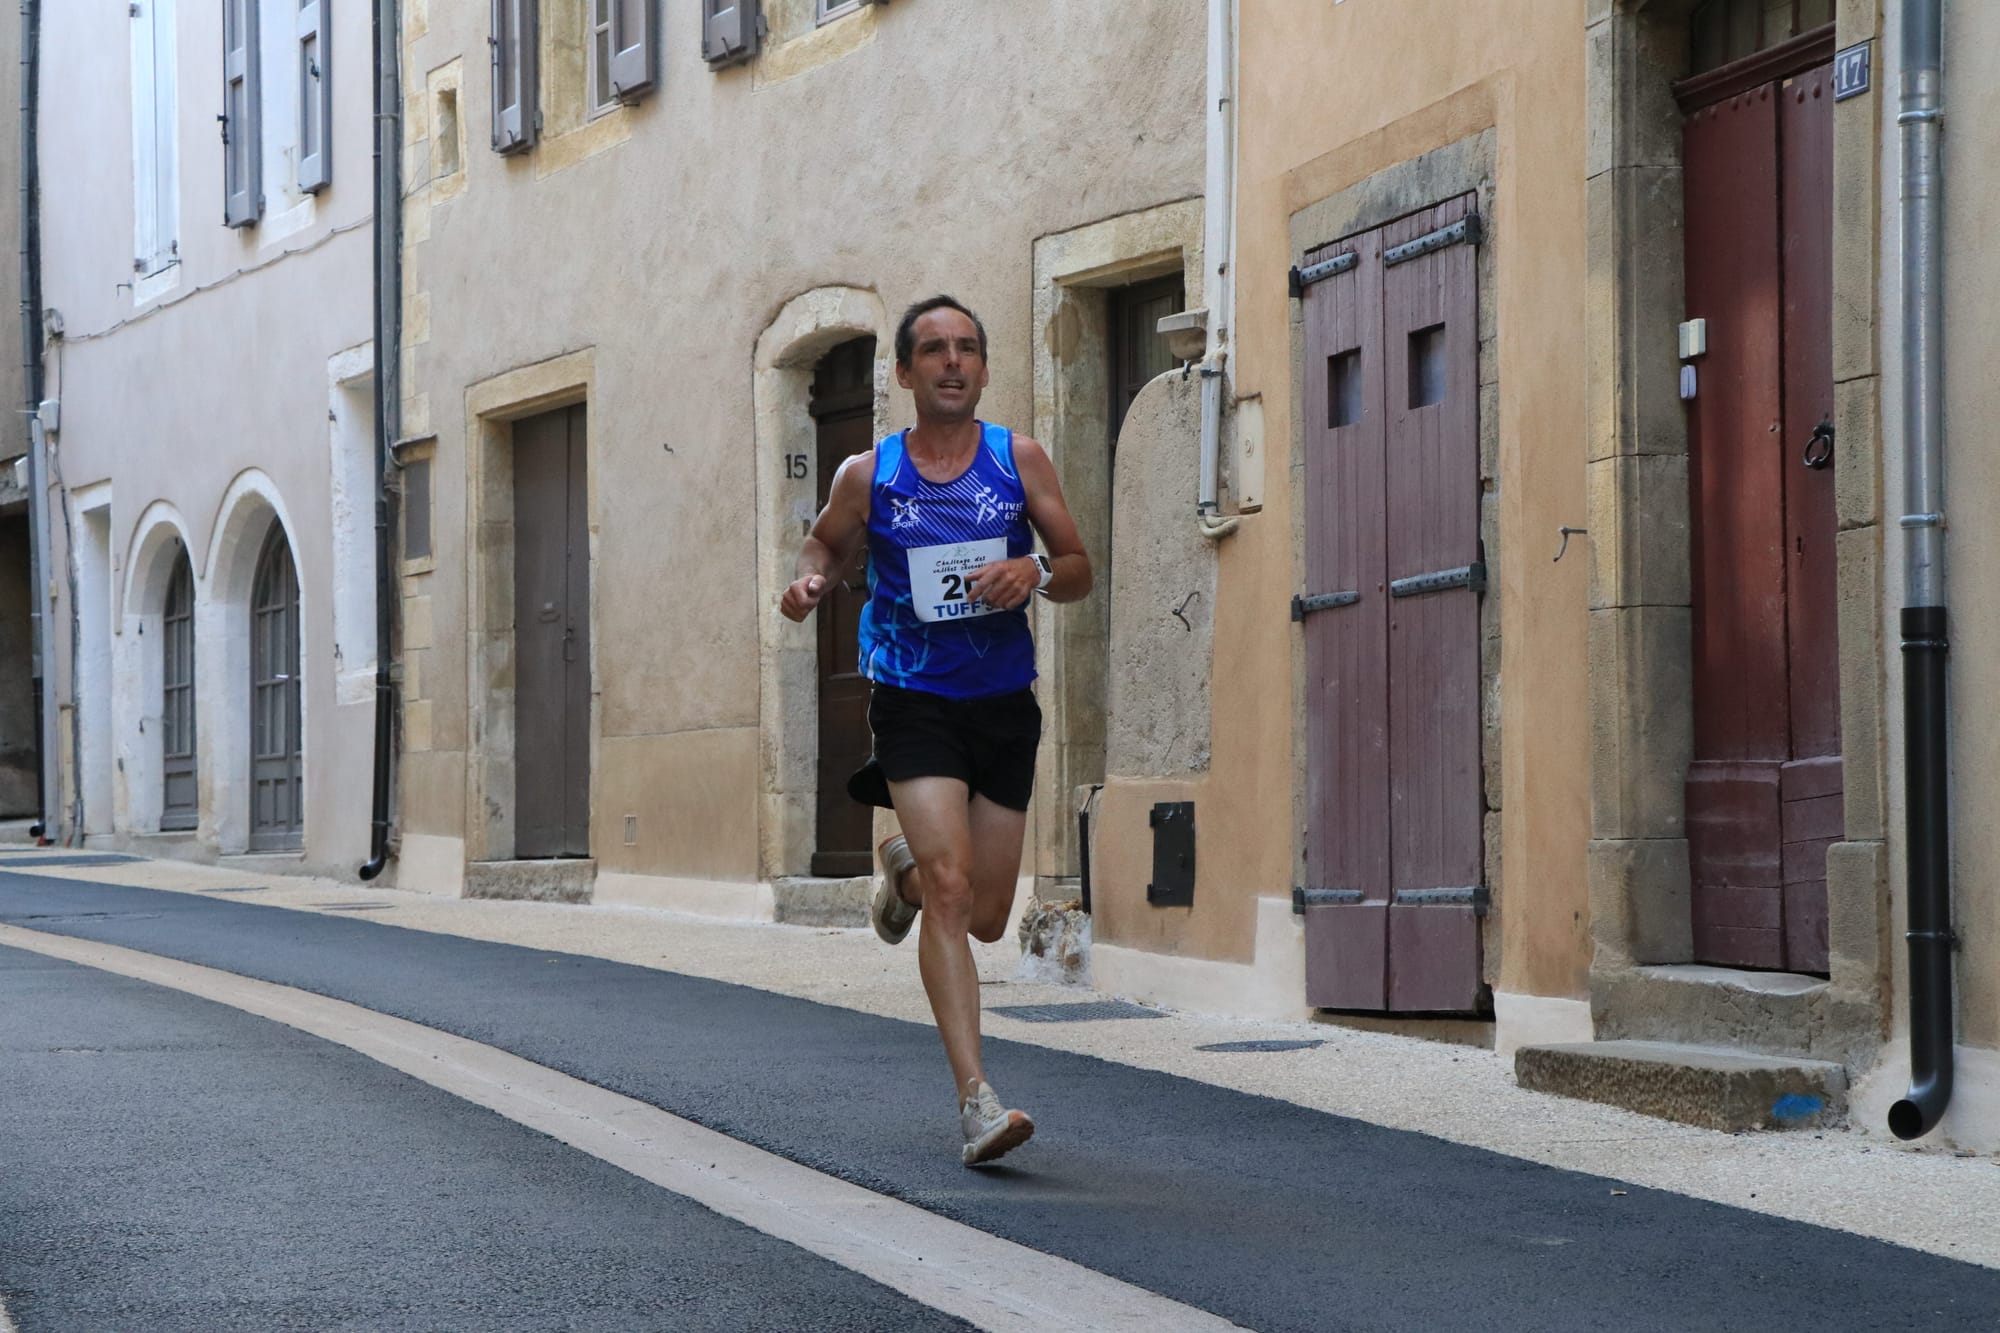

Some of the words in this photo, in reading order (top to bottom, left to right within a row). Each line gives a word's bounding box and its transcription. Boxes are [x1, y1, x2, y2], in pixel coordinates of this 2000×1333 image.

[1841, 53, 1863, 90] 17
[785, 454, 808, 479] 15
[891, 519, 920, 530] SPORT
[935, 558, 970, 567] Challenge
